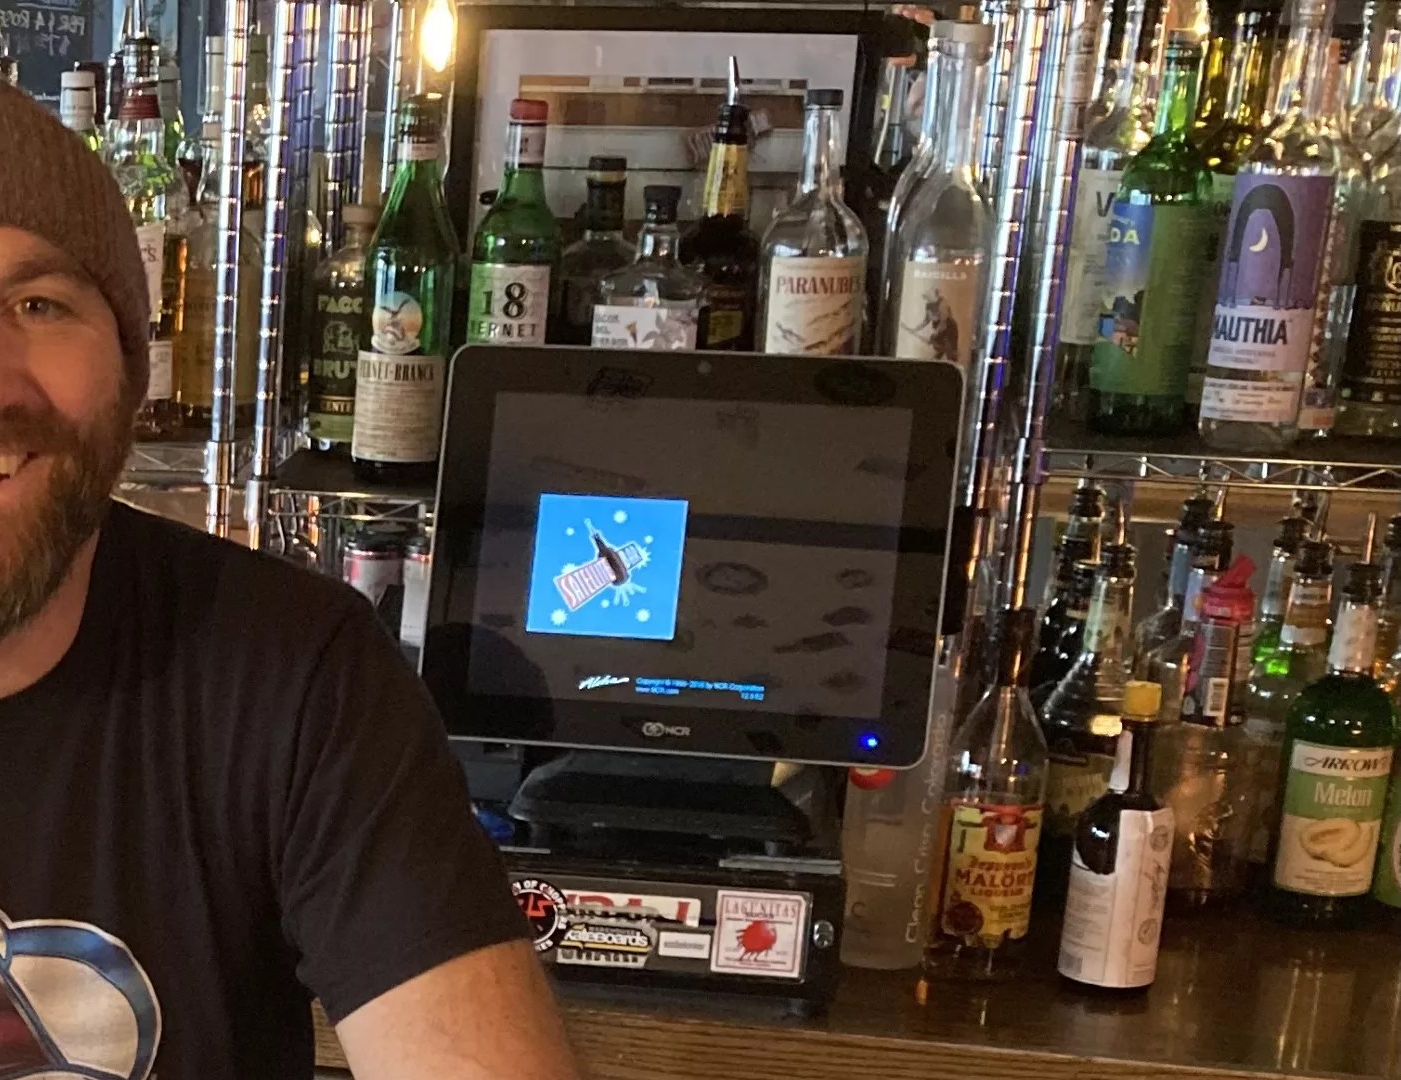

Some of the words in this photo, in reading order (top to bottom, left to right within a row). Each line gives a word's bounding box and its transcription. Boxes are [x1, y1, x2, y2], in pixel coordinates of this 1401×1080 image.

[664, 726, 691, 737] NCR
[1313, 780, 1374, 808] Melon
[724, 898, 798, 919] LAGUNITAS
